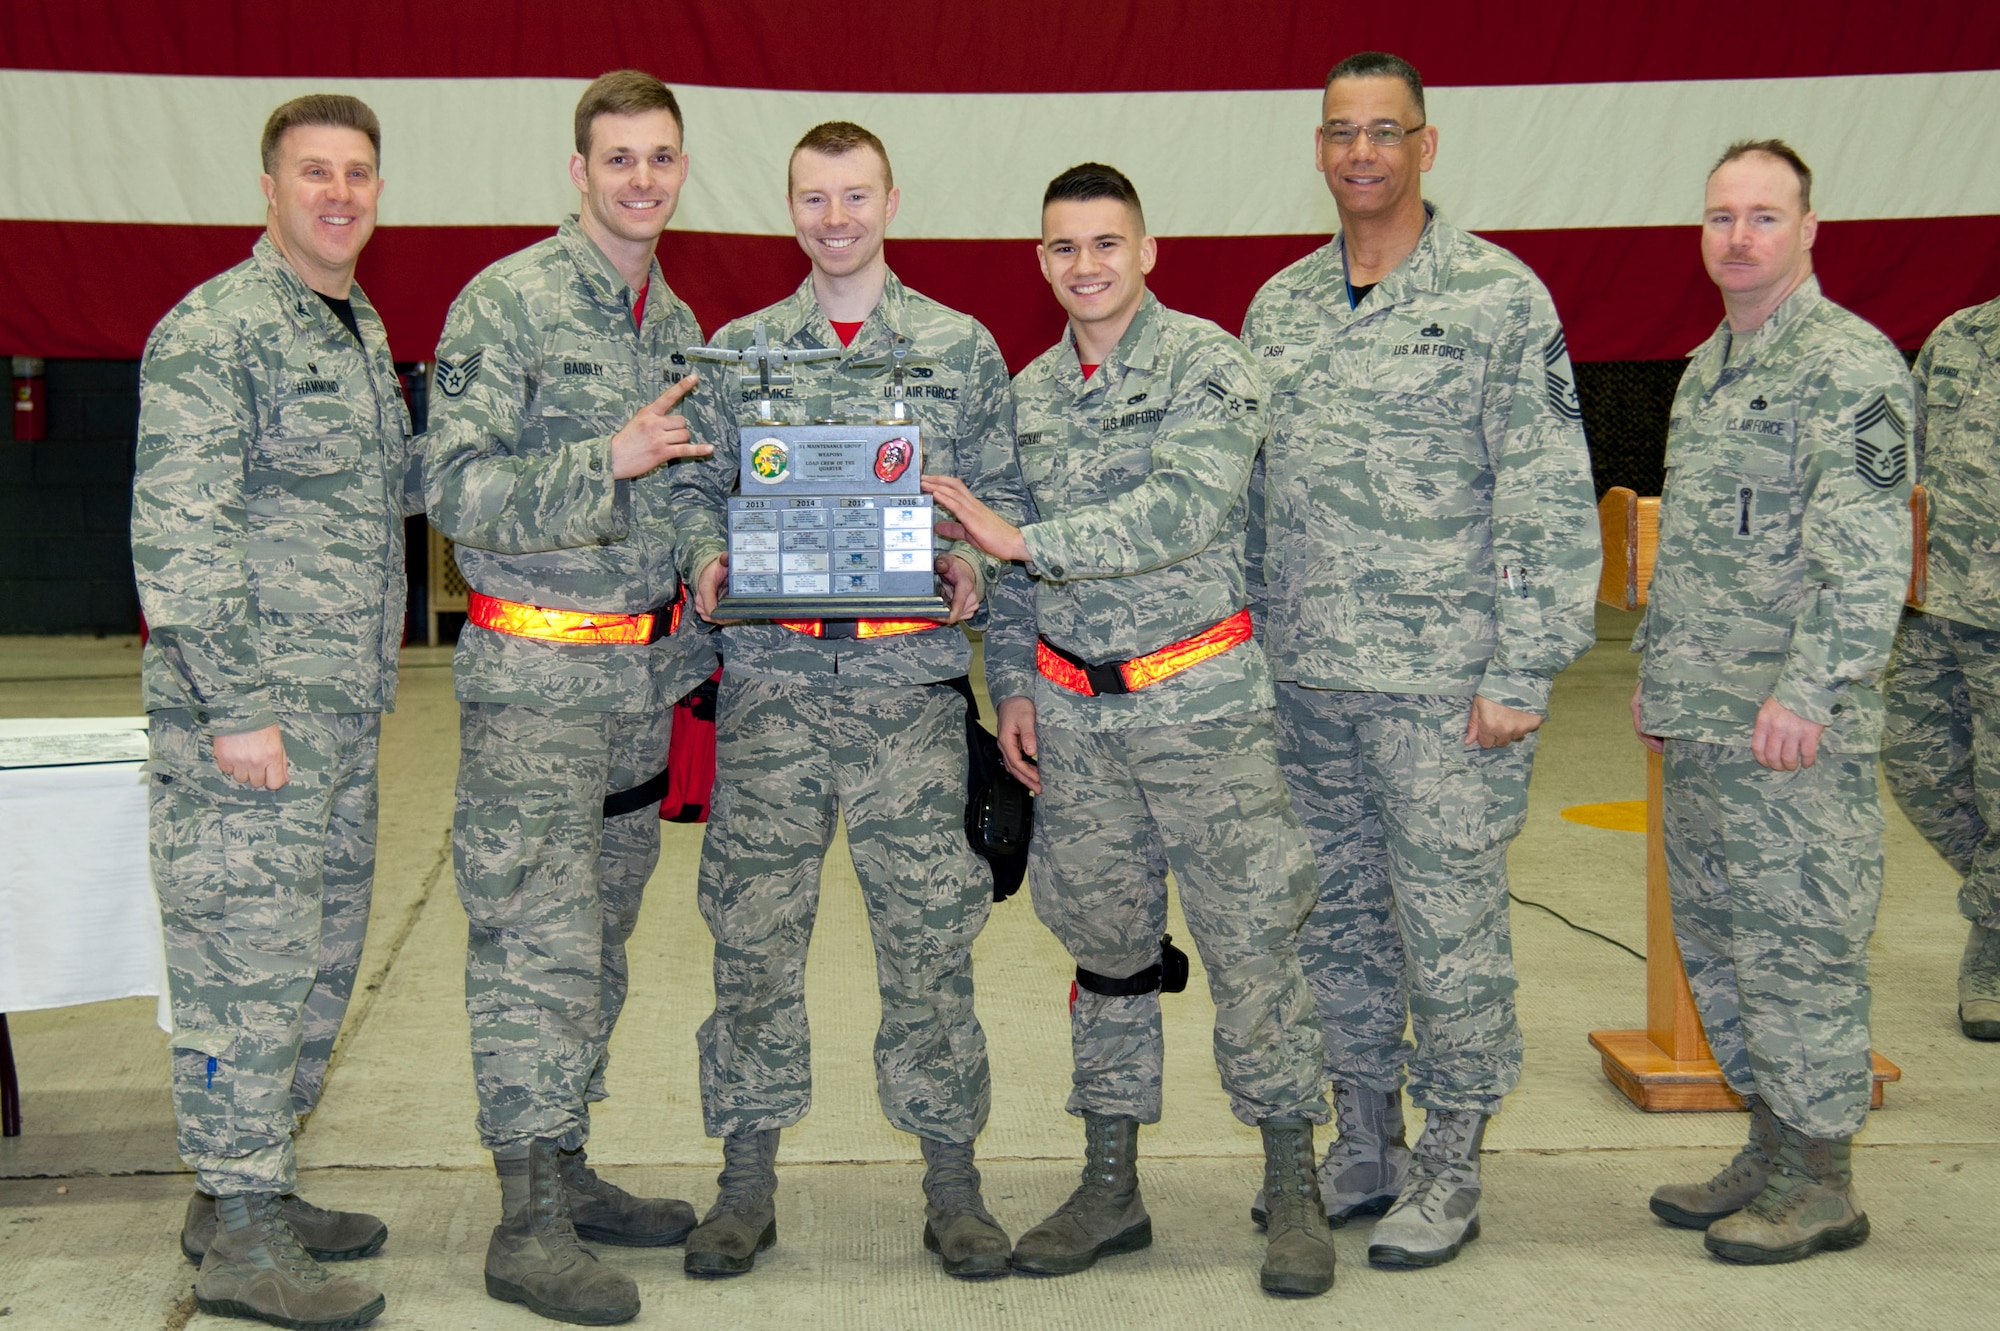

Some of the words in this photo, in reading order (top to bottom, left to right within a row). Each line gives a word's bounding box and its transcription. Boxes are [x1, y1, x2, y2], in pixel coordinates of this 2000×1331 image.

[1263, 345, 1285, 358] CASH
[1412, 344, 1431, 356] AIR
[1431, 344, 1466, 361] FORCE
[563, 362, 604, 376] BADGLEY
[297, 380, 340, 395] HAMMOND
[905, 386, 923, 398] AIR
[925, 386, 959, 400] FORCE
[741, 388, 794, 402] SCHMKE
[1120, 413, 1135, 428] AIR
[1740, 418, 1754, 432] AIR
[1754, 419, 1785, 435] FORCE
